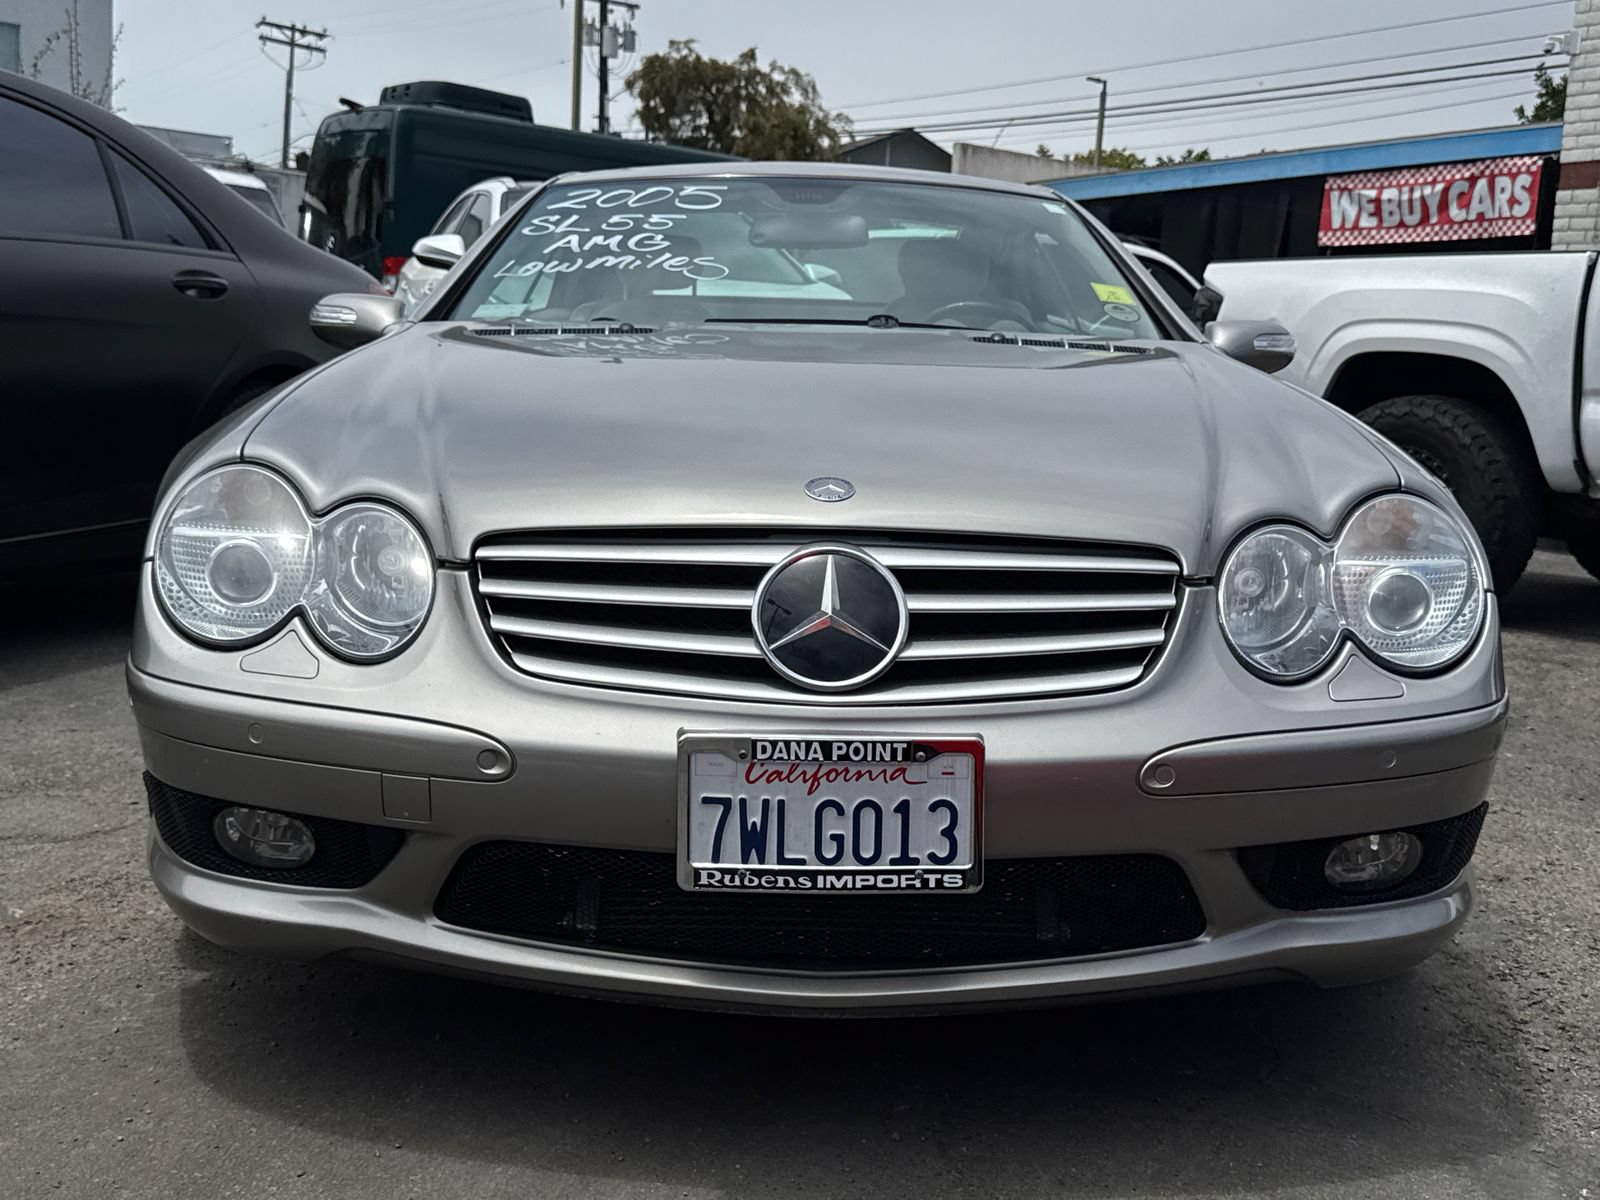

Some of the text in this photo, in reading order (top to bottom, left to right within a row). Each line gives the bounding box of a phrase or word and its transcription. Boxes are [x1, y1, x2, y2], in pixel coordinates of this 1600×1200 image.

[546, 186, 729, 210] 2005
[1329, 173, 1533, 230] WE BUY CARS
[521, 213, 687, 236] SL 55
[543, 232, 672, 254] AMG
[756, 741, 907, 762] DANA POINT
[744, 761, 928, 796] California
[700, 796, 959, 866] 7WLG013
[698, 869, 964, 889] Rubens IMPORTS
